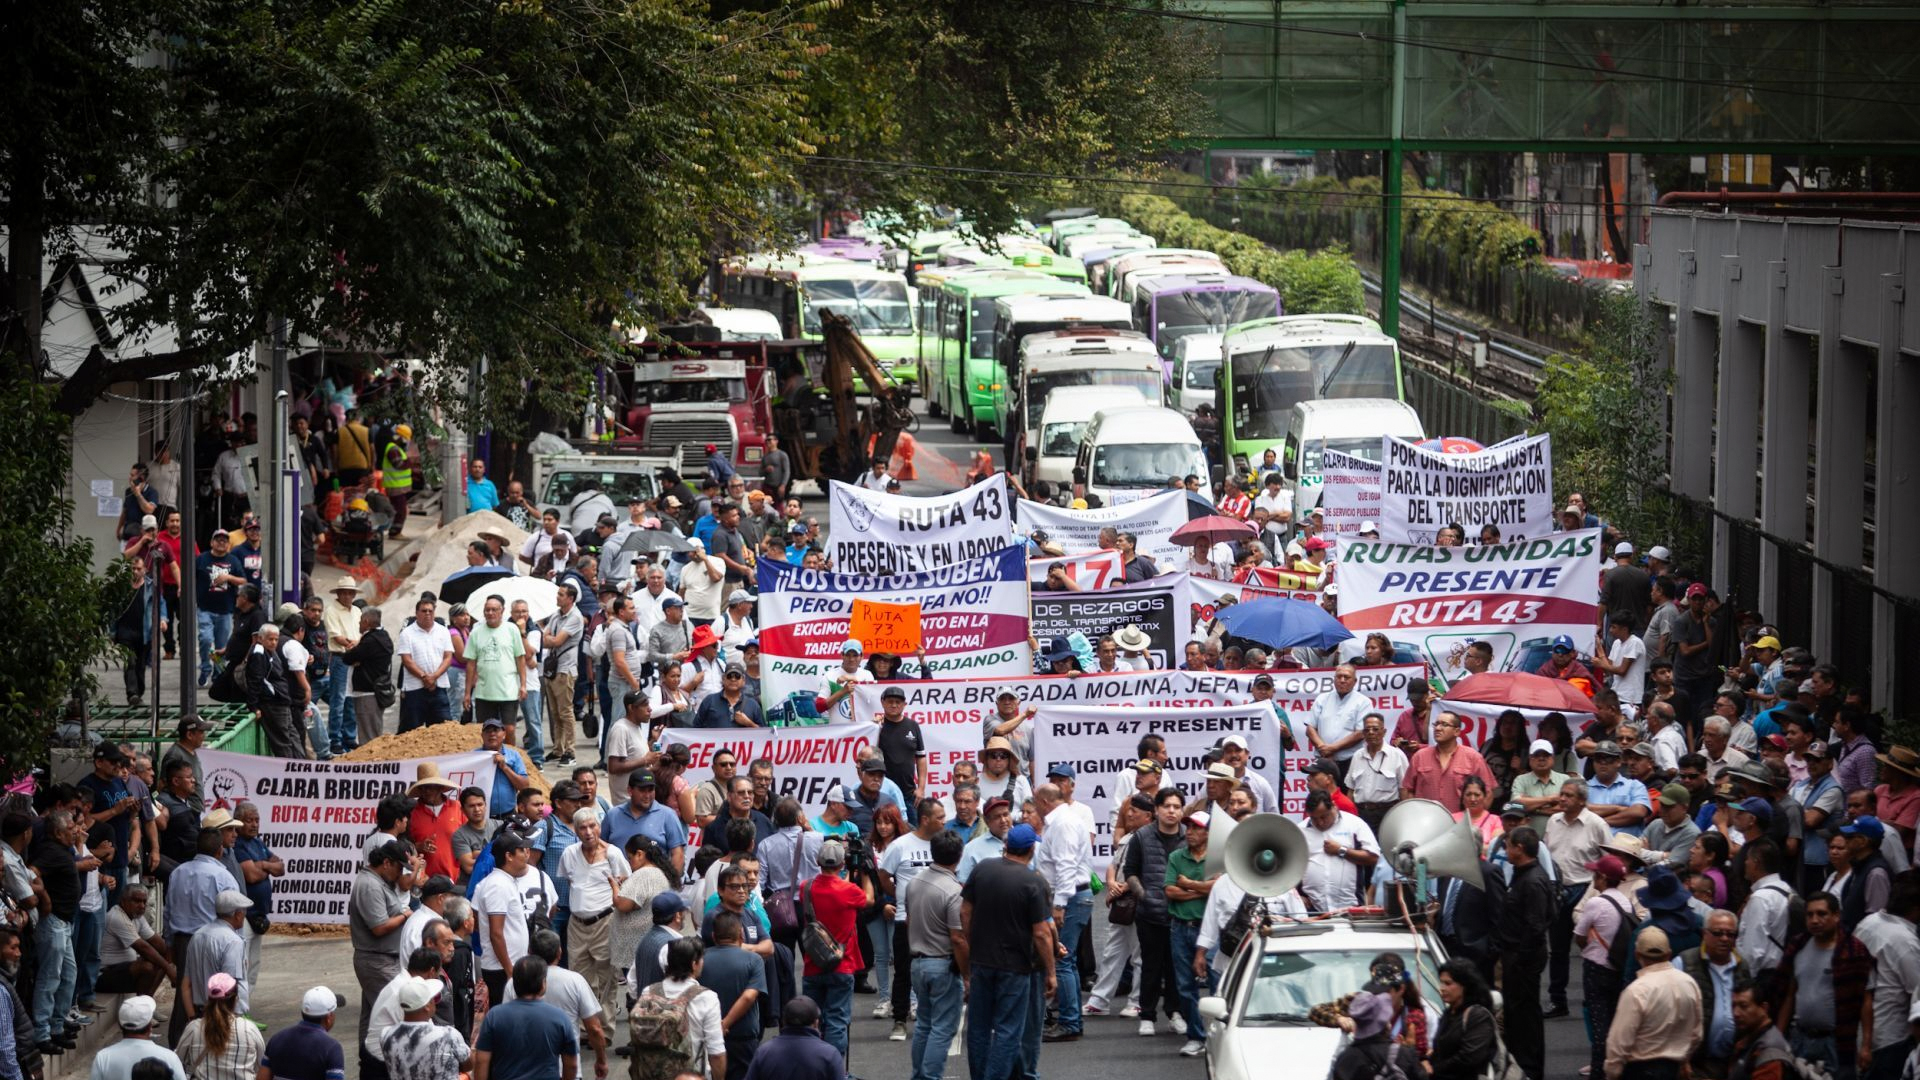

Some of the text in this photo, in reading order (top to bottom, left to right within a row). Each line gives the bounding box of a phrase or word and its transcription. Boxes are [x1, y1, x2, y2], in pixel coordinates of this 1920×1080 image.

[1323, 453, 1348, 470] CLARA
[1390, 442, 1416, 467] POR
[1420, 453, 1448, 472] UNA
[1452, 454, 1499, 474] TARIFA
[1502, 442, 1543, 468] JUSTA
[1387, 469, 1546, 497] PARA LA DIGNIFICACION
[1369, 492, 1381, 501] IGUA
[898, 487, 1002, 532] RUTA 43
[1333, 508, 1355, 517] SERVICIO
[1357, 508, 1380, 517] PUBLICOS
[1408, 499, 1526, 525] DEL TRANSPORTE
[1055, 524, 1078, 532] AUMENTO
[1136, 521, 1152, 529] COSTO
[1323, 524, 1334, 533] ESTA
[1337, 523, 1361, 533] OLICITUD
[837, 541, 916, 573] PRESENTE
[916, 544, 928, 571] Y
[932, 542, 953, 569] EN
[1153, 546, 1180, 554] INCREMENT
[1342, 542, 1452, 564] RUTAS
[1463, 535, 1597, 563] UNIDAS
[833, 571, 918, 593] COSTOS
[922, 556, 1003, 588] SUBEN,
[1379, 567, 1562, 593] PRESENTE
[790, 596, 844, 613] PERO
[949, 585, 993, 607] NO!!
[1035, 599, 1165, 617] DE REZAGOS
[949, 615, 970, 629] EN
[970, 614, 989, 627] LA
[1050, 619, 1071, 627] DEL
[1073, 614, 1143, 627] TRANSPORTE
[1388, 600, 1546, 627] RUTA 43
[873, 623, 895, 636] 73
[1031, 626, 1092, 636] CESIONADO
[1094, 626, 1110, 634] DE
[863, 639, 911, 650] APOYA
[925, 637, 934, 649] Y
[935, 631, 986, 649] DIGNA!
[771, 661, 818, 676] PARA
[899, 649, 1019, 674] RABAJANDO.
[908, 688, 961, 705] ARA
[1085, 677, 1178, 699] MOLINA,
[1185, 677, 1239, 694] JEFA
[1285, 672, 1413, 694] GOBRNO:
[1053, 716, 1262, 737] RUTA 47 PRESENTE
[761, 735, 870, 766] AUMENTO
[1048, 758, 1139, 774] EXIGIMO
[1163, 755, 1267, 771] AUMO
[256, 778, 319, 799] CLARA
[1092, 785, 1107, 799] A
[271, 805, 378, 824] RUTA 4 PRESEN
[257, 833, 306, 849] ERVICIO
[309, 833, 352, 850] DIGNO,
[287, 859, 353, 874] GOBIERNO
[272, 879, 351, 895] HOMOLOGAR
[277, 900, 326, 915] ESTADO
[328, 901, 345, 916] DE
